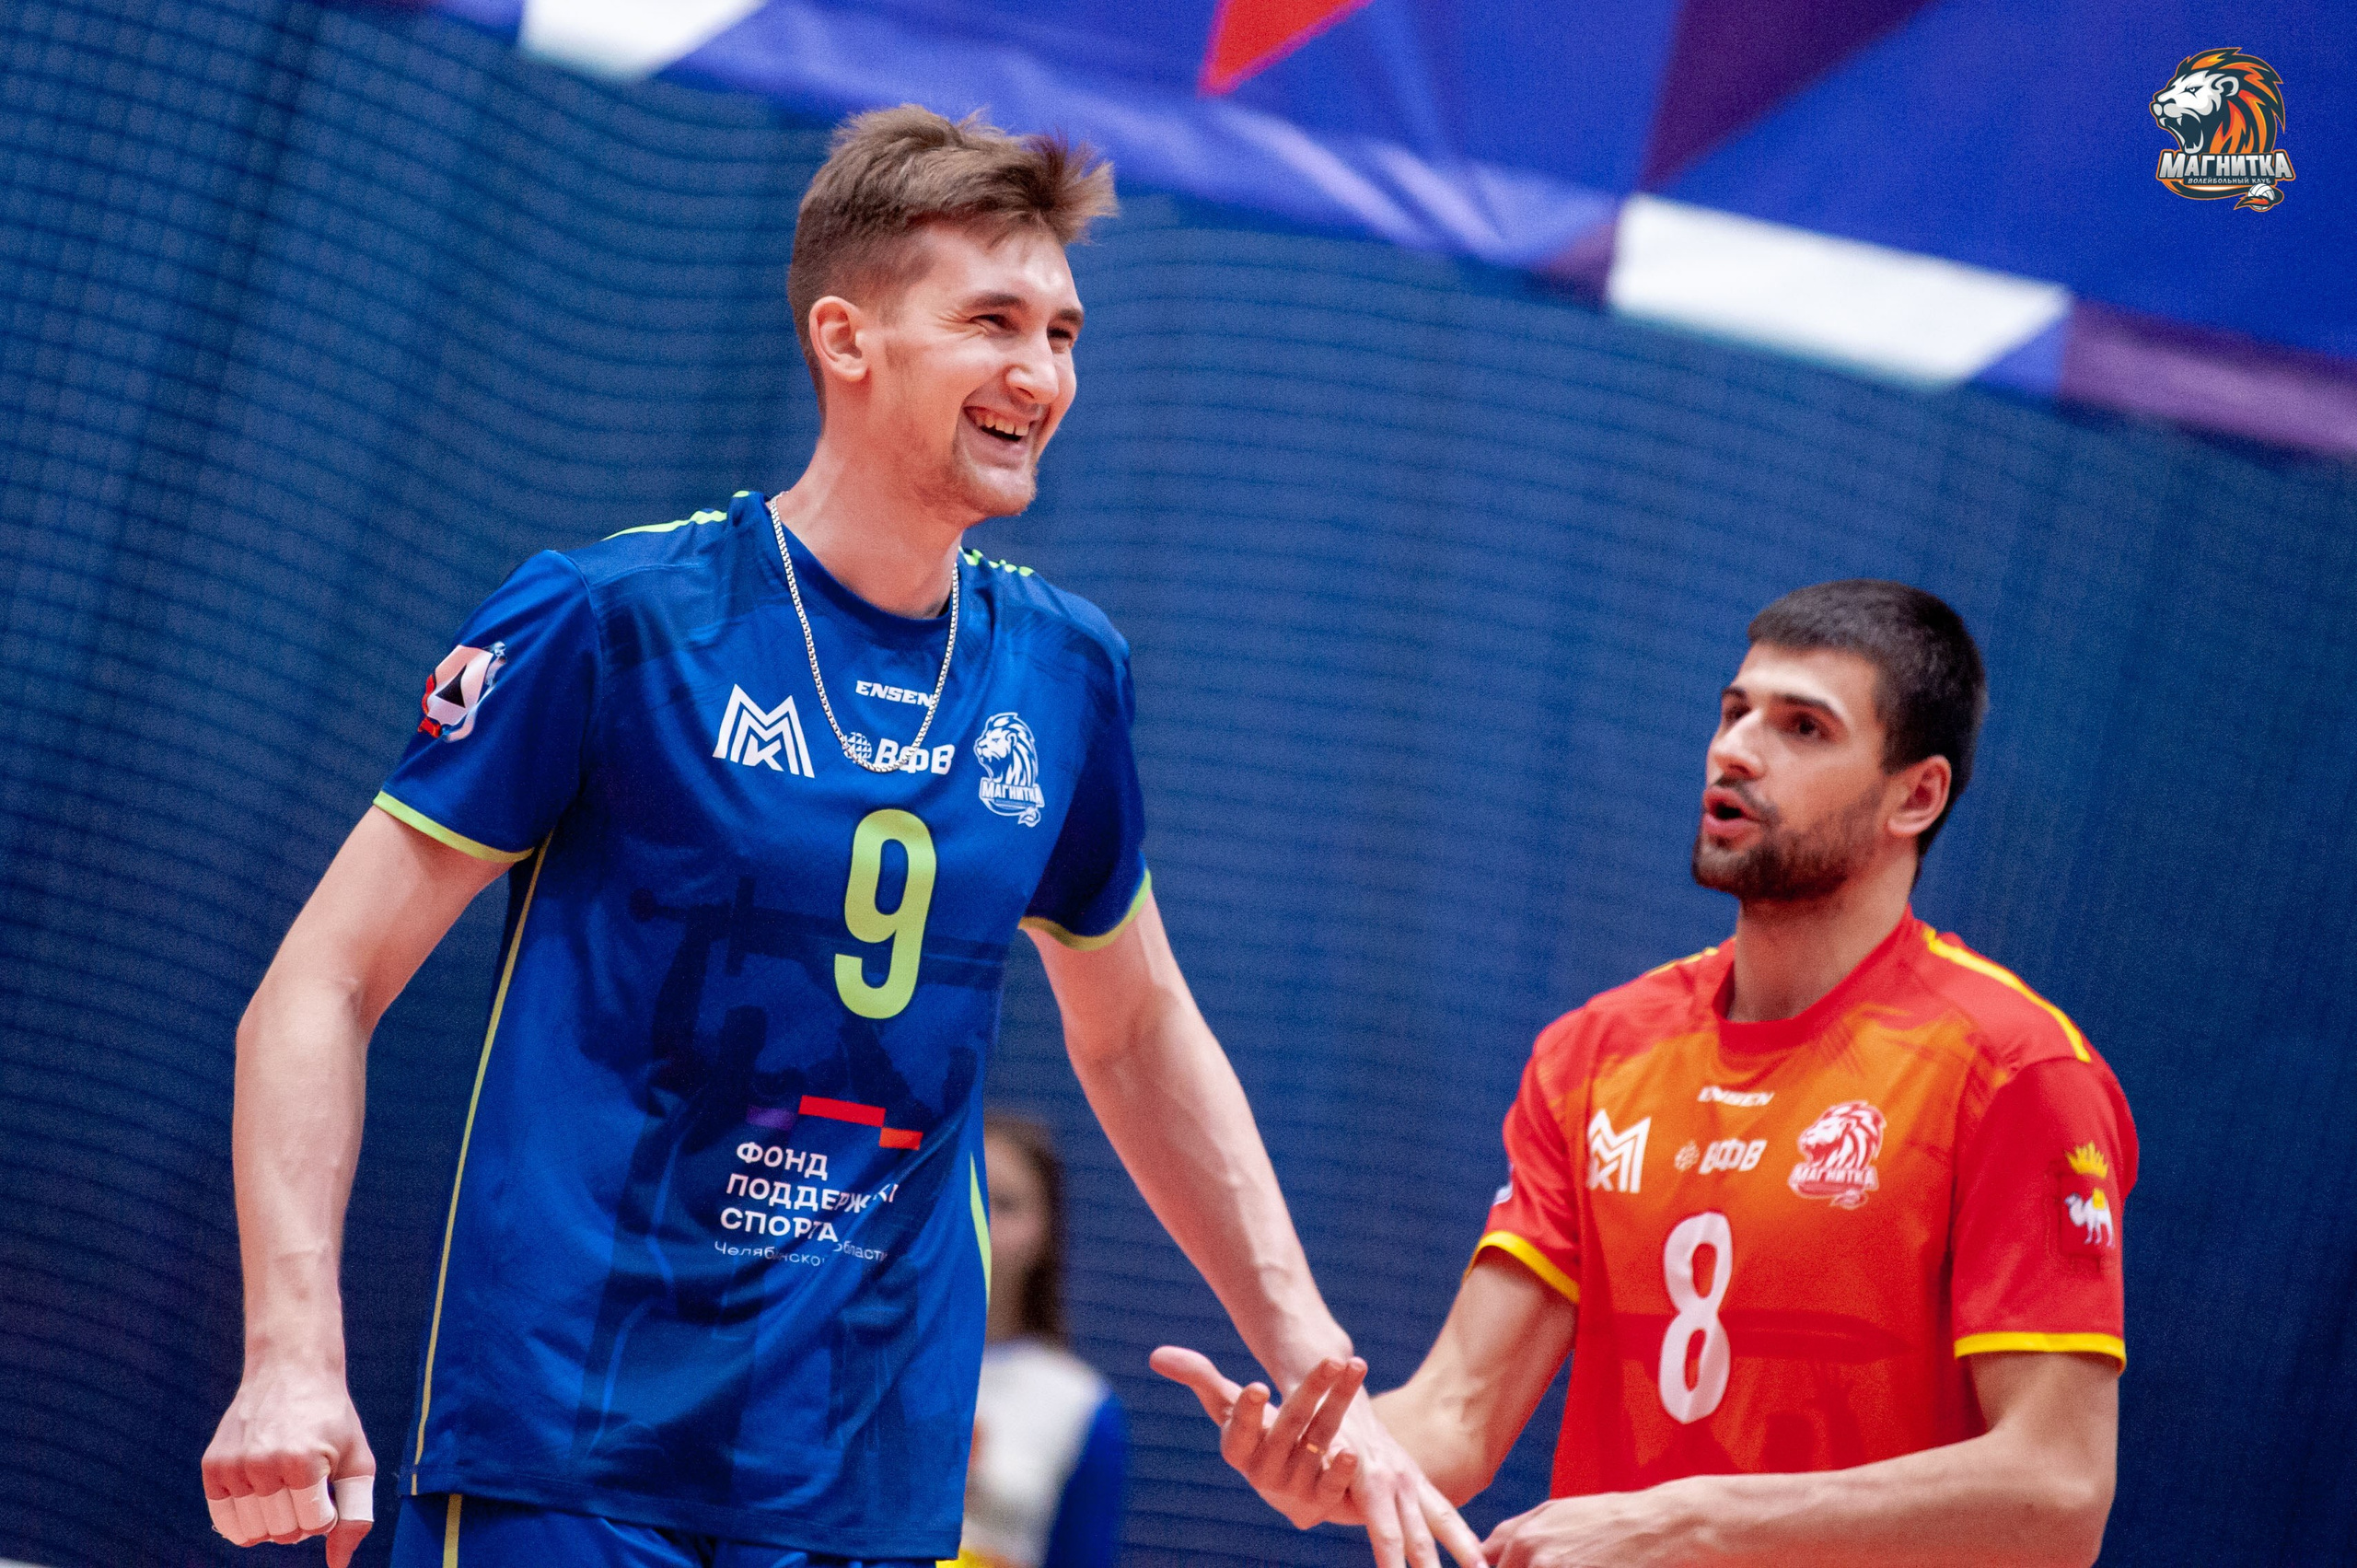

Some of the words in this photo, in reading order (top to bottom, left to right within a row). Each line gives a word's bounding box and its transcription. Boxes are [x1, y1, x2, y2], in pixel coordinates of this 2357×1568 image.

[855, 680, 934, 707] ENSEN
[981, 780, 1043, 807] МАГНИТКА
[834, 808, 936, 1019] 9
[737, 1142, 828, 1181] ФОНД
[1792, 1165, 1877, 1190] МАГНИТКА
[720, 1207, 839, 1242] СПОРТА
[1659, 1211, 1733, 1424] 8
